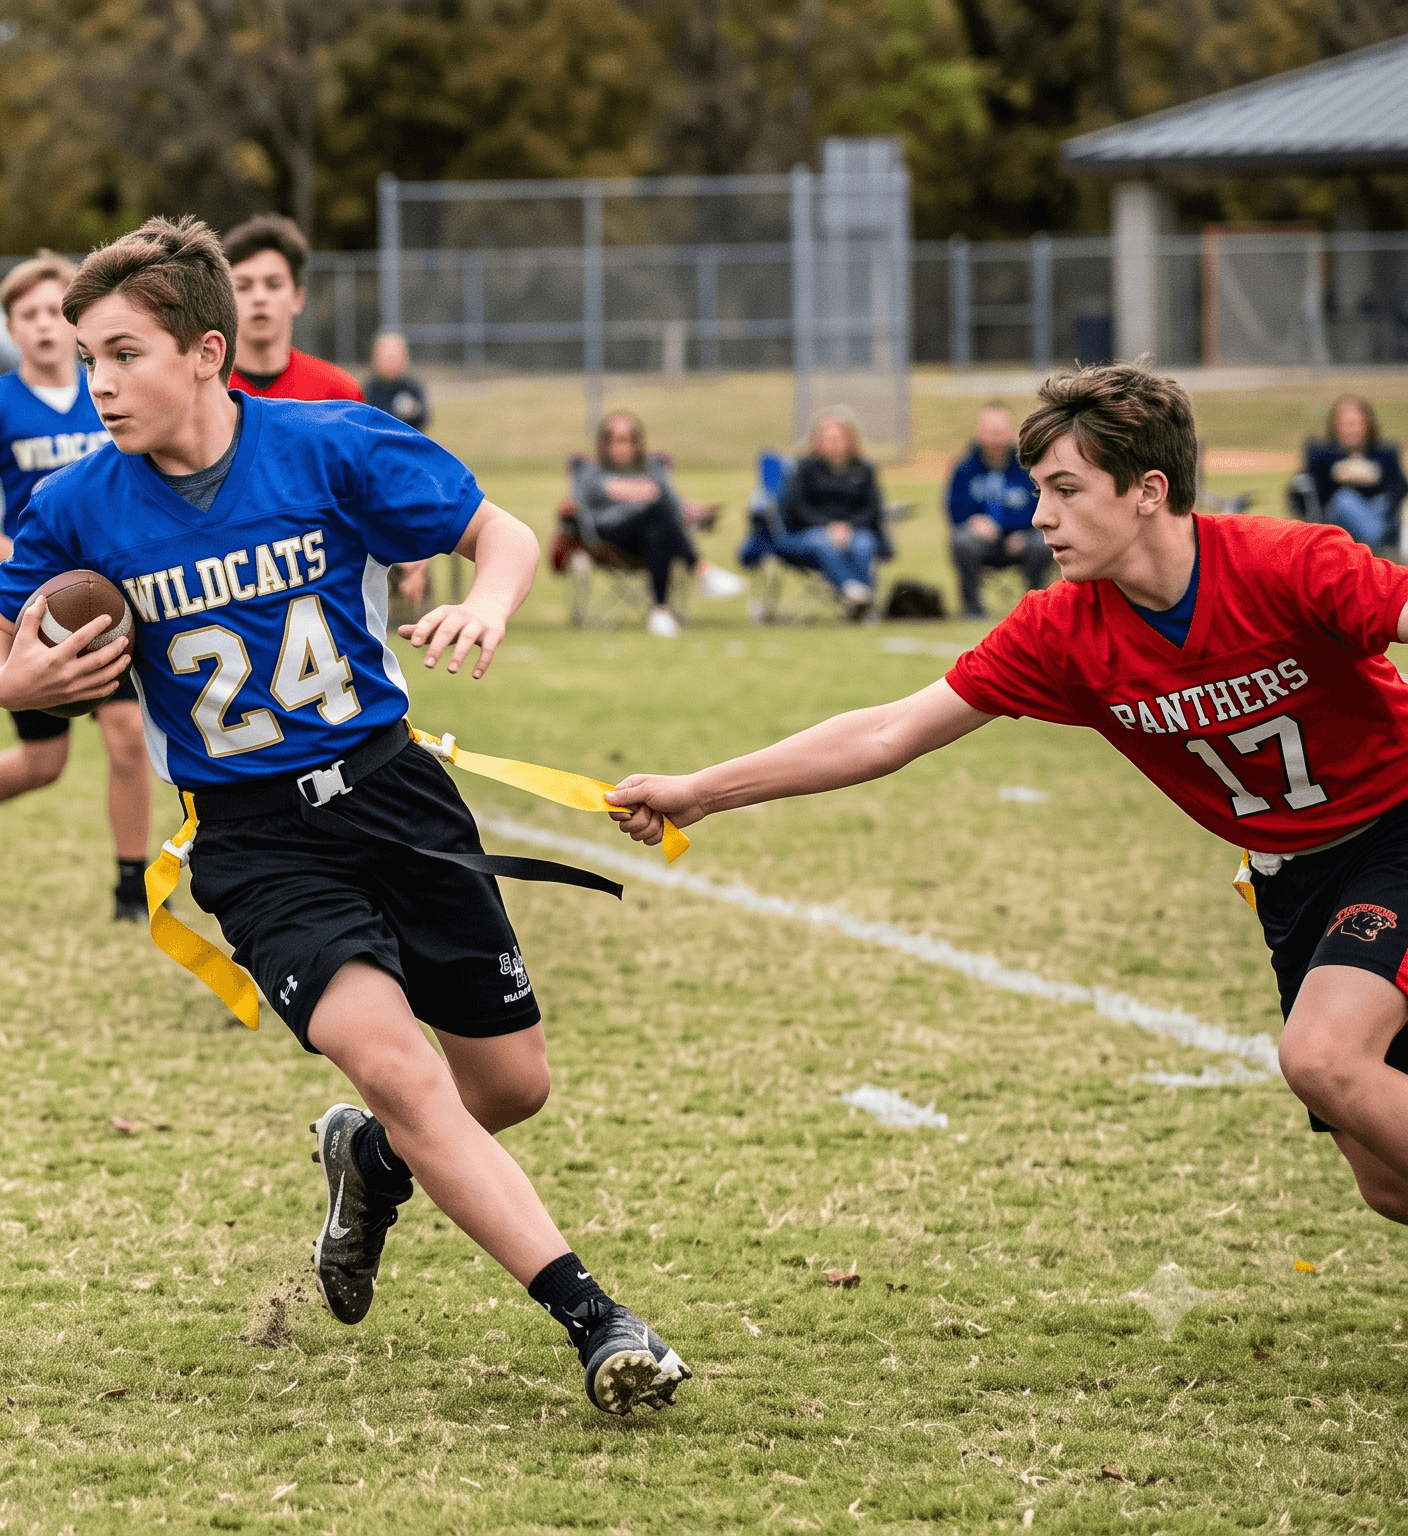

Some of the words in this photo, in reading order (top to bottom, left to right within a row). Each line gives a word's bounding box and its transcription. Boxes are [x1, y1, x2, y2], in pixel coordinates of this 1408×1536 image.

[122, 529, 328, 622] WILDCATS
[166, 594, 362, 758] 24
[1110, 657, 1309, 734] PANTHERS
[1184, 714, 1328, 817] 17
